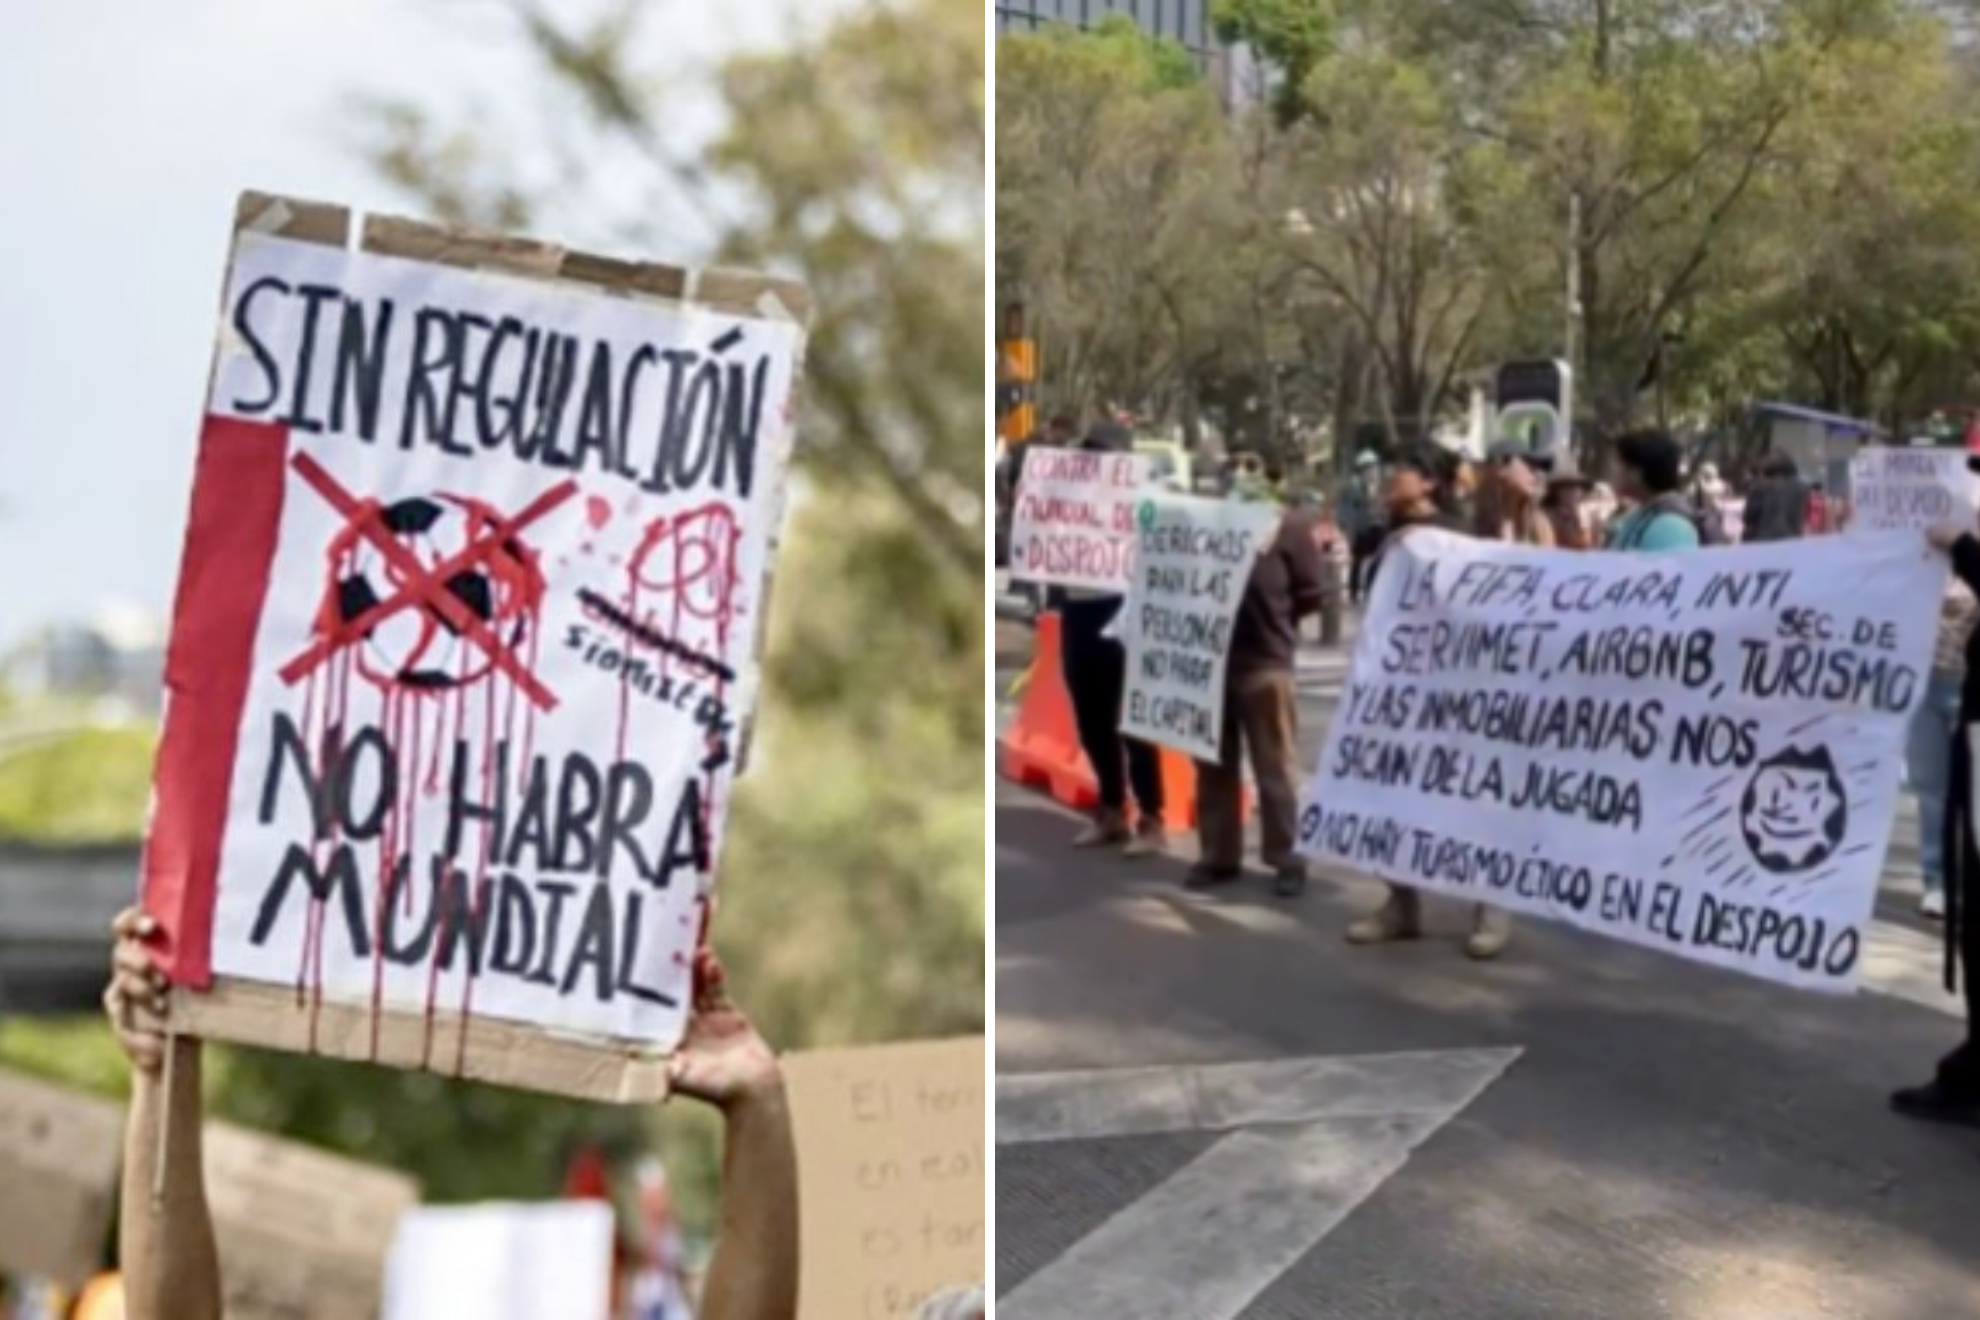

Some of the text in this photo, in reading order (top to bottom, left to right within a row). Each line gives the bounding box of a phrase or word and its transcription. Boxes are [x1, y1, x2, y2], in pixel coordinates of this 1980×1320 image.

[232, 276, 769, 497] SIN REGULACIÓN
[1111, 457, 1137, 488] EL
[1191, 567, 1232, 603] LAS
[1398, 558, 1438, 611] LA
[1552, 571, 1683, 621] CLARA,
[1694, 569, 1793, 609] INTI
[1142, 648, 1168, 680] NO
[1852, 617, 1898, 651] DE
[1131, 688, 1147, 725] EL
[1739, 637, 1918, 714] TURISMO
[1416, 688, 1664, 760] INMOBILIARIAS
[1670, 715, 1760, 769] NOS
[258, 710, 729, 888] NO HABRÁ
[1420, 744, 1460, 796] DE
[1459, 754, 1504, 802] LA
[1510, 760, 1643, 833] JUGADA
[249, 841, 679, 1008] MUNDIAL
[1319, 811, 1860, 976] NO HAY TURISMO ÉTICO EN EL DESPOJO
